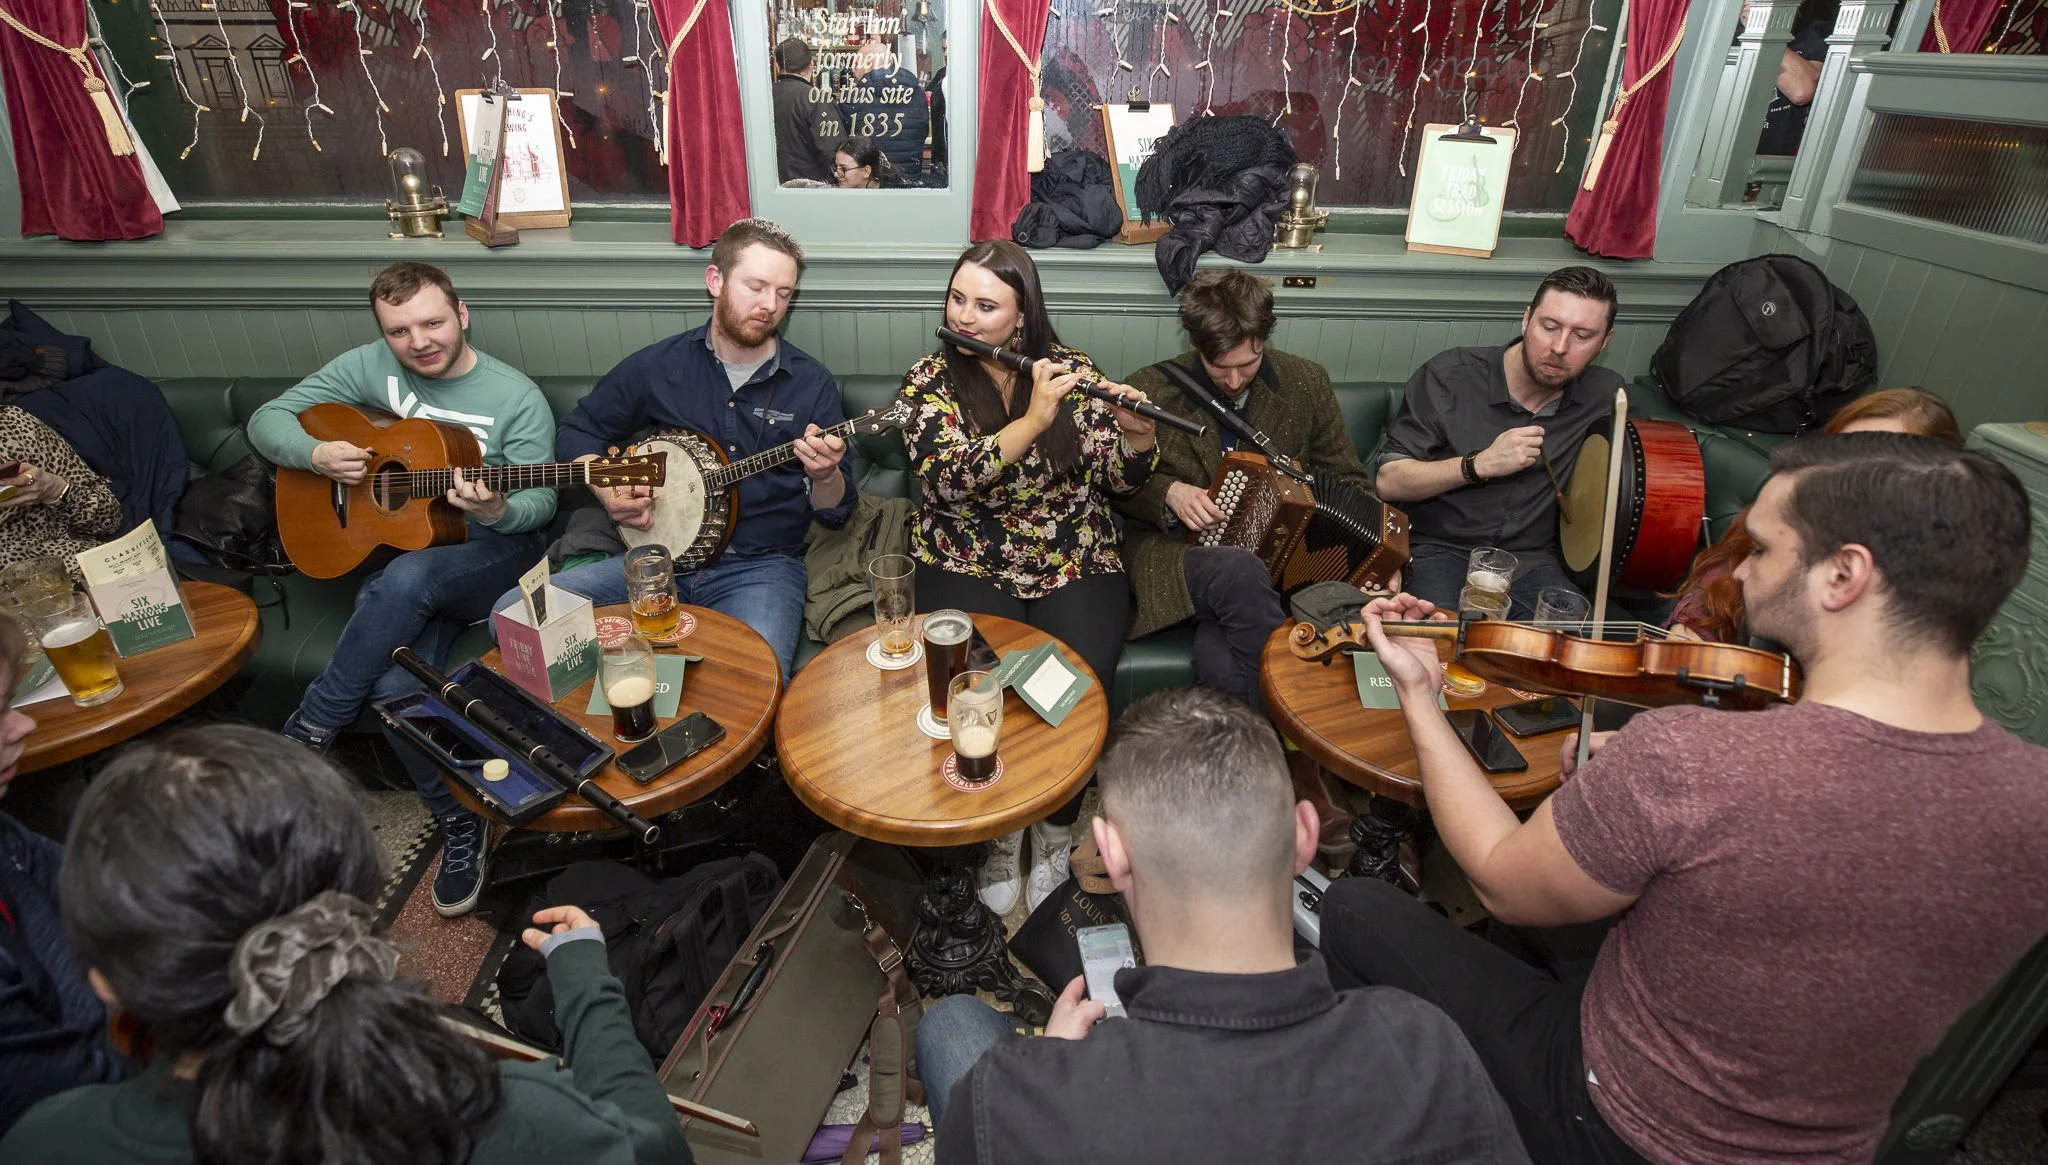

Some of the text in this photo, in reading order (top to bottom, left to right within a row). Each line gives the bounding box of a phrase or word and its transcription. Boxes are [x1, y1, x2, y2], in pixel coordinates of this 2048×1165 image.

[815, 8, 901, 35] Star Inn
[813, 39, 902, 78] formerly
[808, 77, 914, 104] on this site
[820, 111, 905, 137] in 1835
[1138, 138, 1153, 153] SIX
[1441, 165, 1487, 183] FRIDAY
[1432, 199, 1484, 217] SESSION
[131, 595, 151, 609] SIX
[121, 602, 169, 624] NATIONS
[137, 615, 163, 631] LIVE
[509, 637, 533, 656] FRIDAY
[564, 633, 578, 648] SIX
[515, 650, 531, 665] LIVE
[556, 638, 590, 666] NATIONS
[566, 653, 584, 671] LIVE
[1072, 889, 1106, 926] LOUIS
